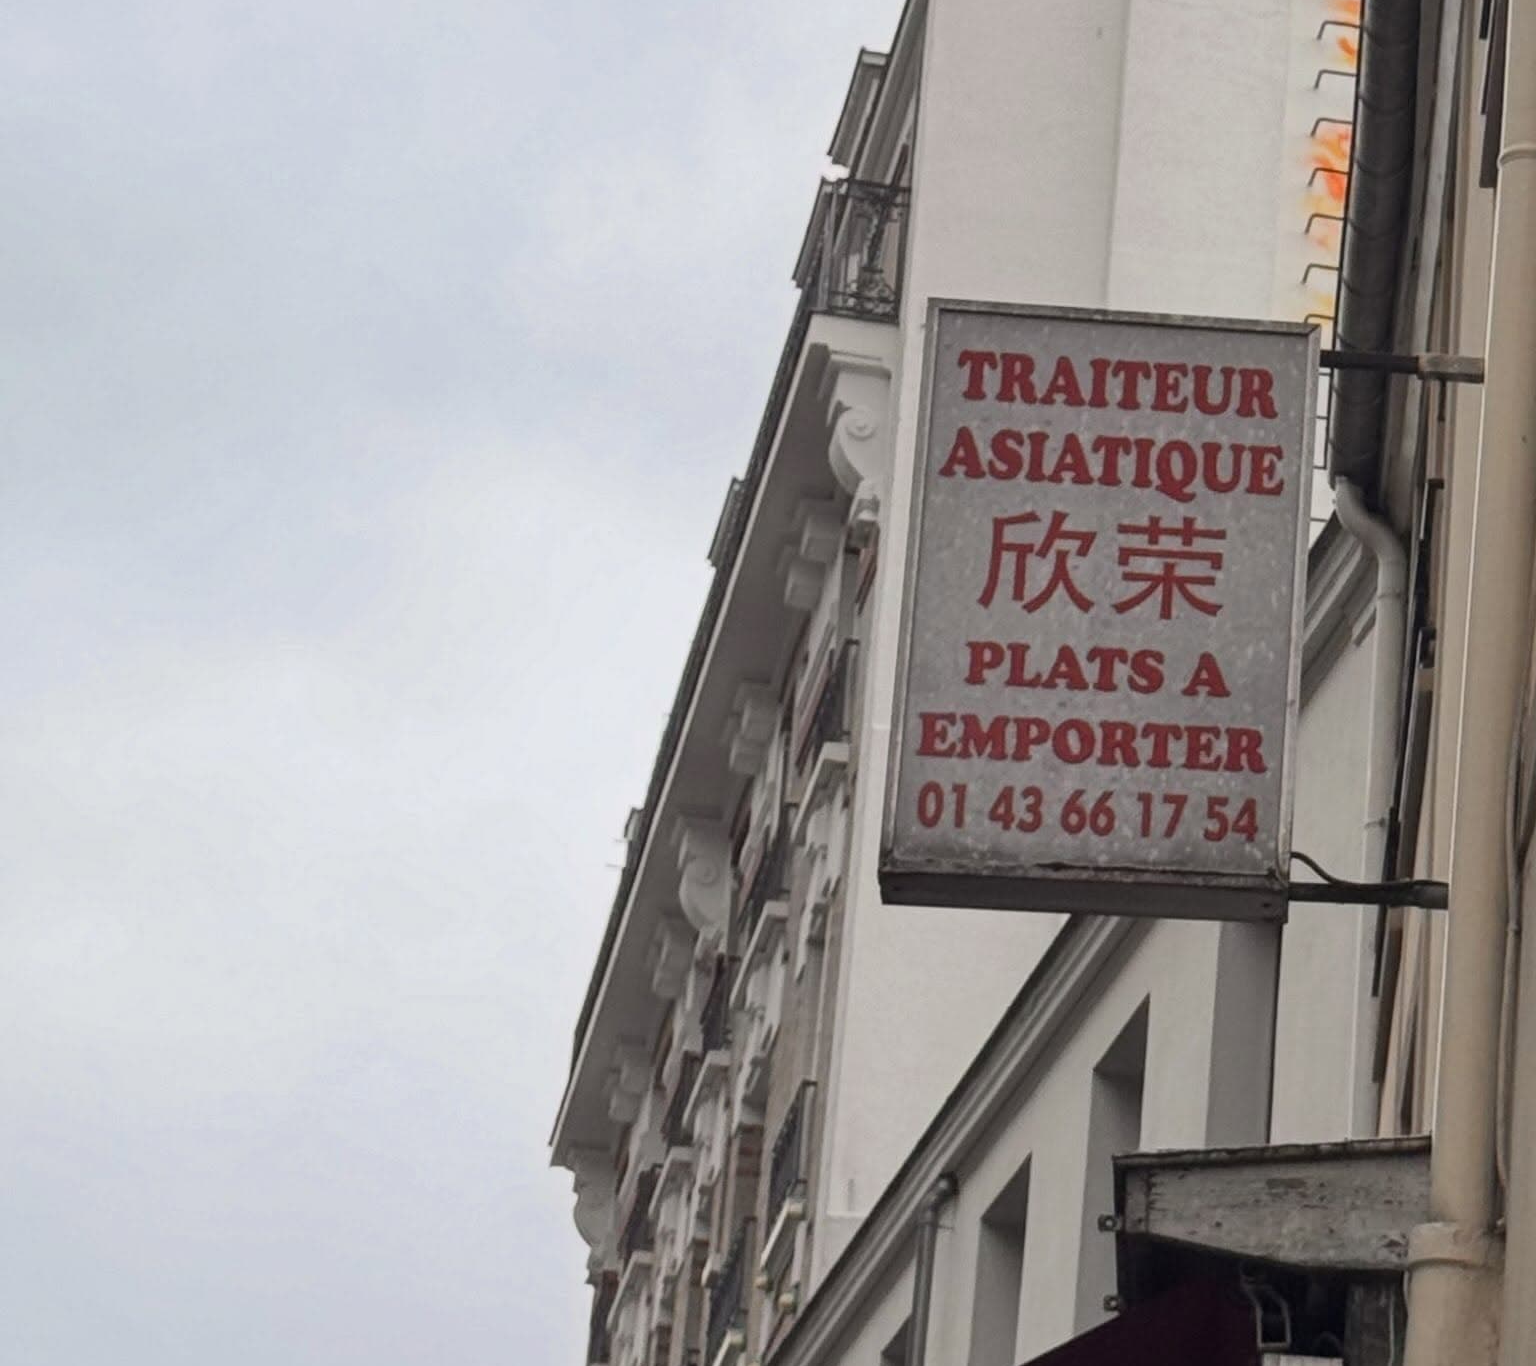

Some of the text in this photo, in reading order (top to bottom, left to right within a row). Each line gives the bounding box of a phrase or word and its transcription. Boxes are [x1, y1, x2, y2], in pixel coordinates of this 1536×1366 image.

[958, 349, 1278, 419] TRAITEUR
[939, 427, 1284, 502] ASIATIQUE
[978, 511, 1227, 620] 欣荣
[965, 641, 1231, 698] PLATS A
[917, 712, 1267, 774] EMPORTER
[917, 782, 1258, 842] 01 43 66 17 54
